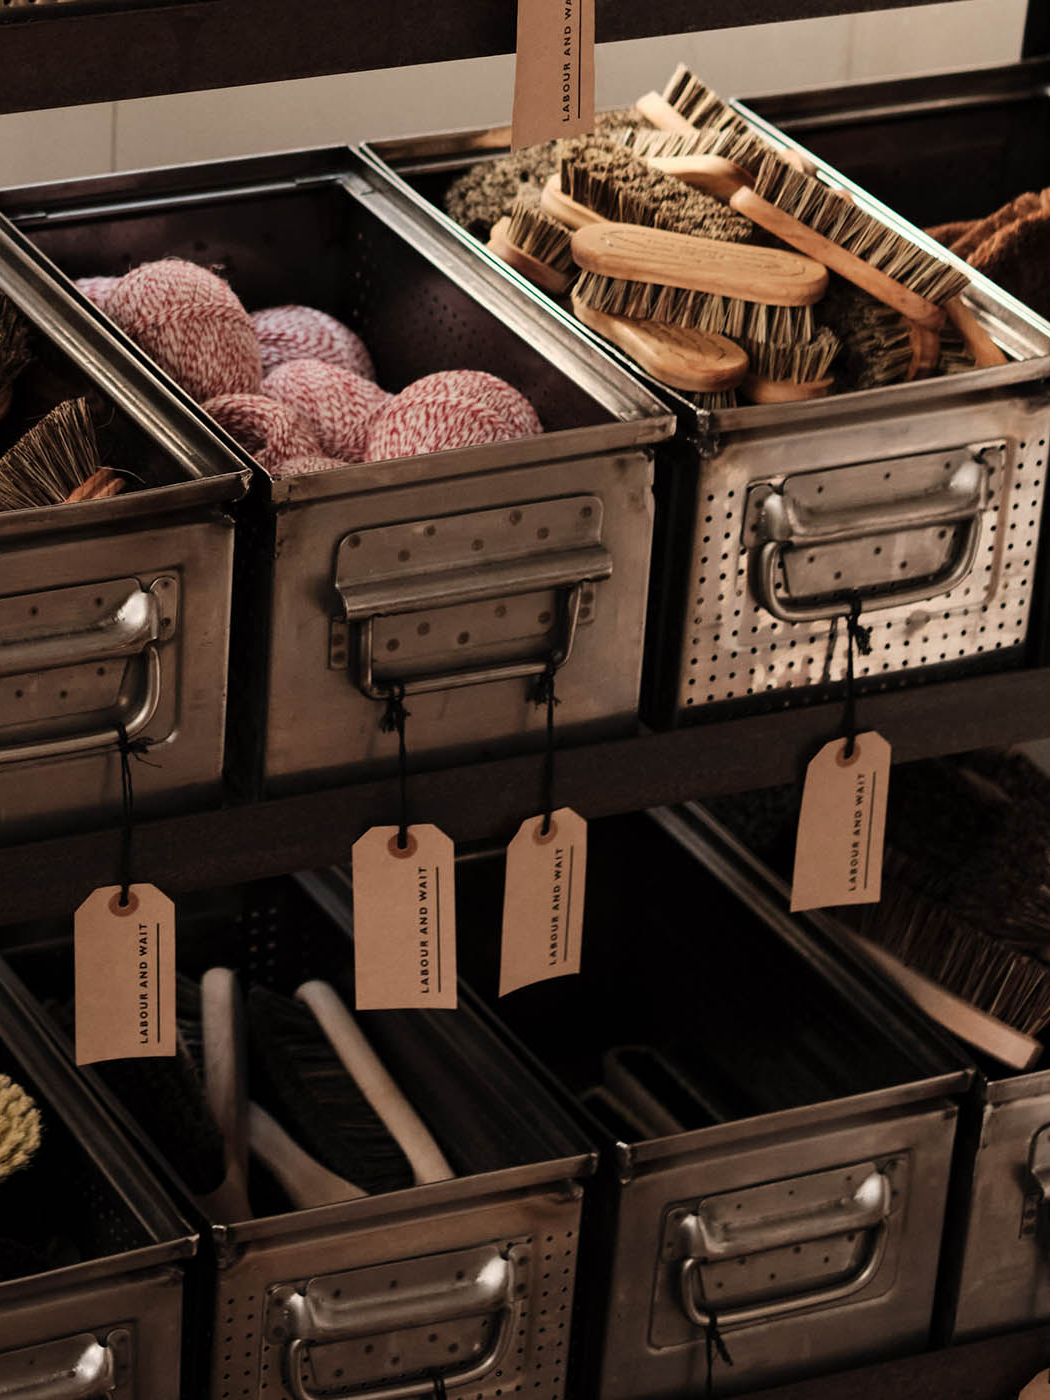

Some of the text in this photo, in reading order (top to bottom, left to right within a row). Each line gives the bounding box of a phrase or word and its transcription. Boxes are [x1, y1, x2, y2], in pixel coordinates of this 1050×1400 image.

[562, 62, 571, 122] LABOUR
[563, 25, 572, 57] AND
[848, 773, 865, 892] LABOUR AND WAIT
[418, 866, 430, 994] LABOUR AND WAIT
[549, 849, 564, 966] LABOUR AND WAIT
[138, 923, 149, 1045] LABOUR AND WAIT
